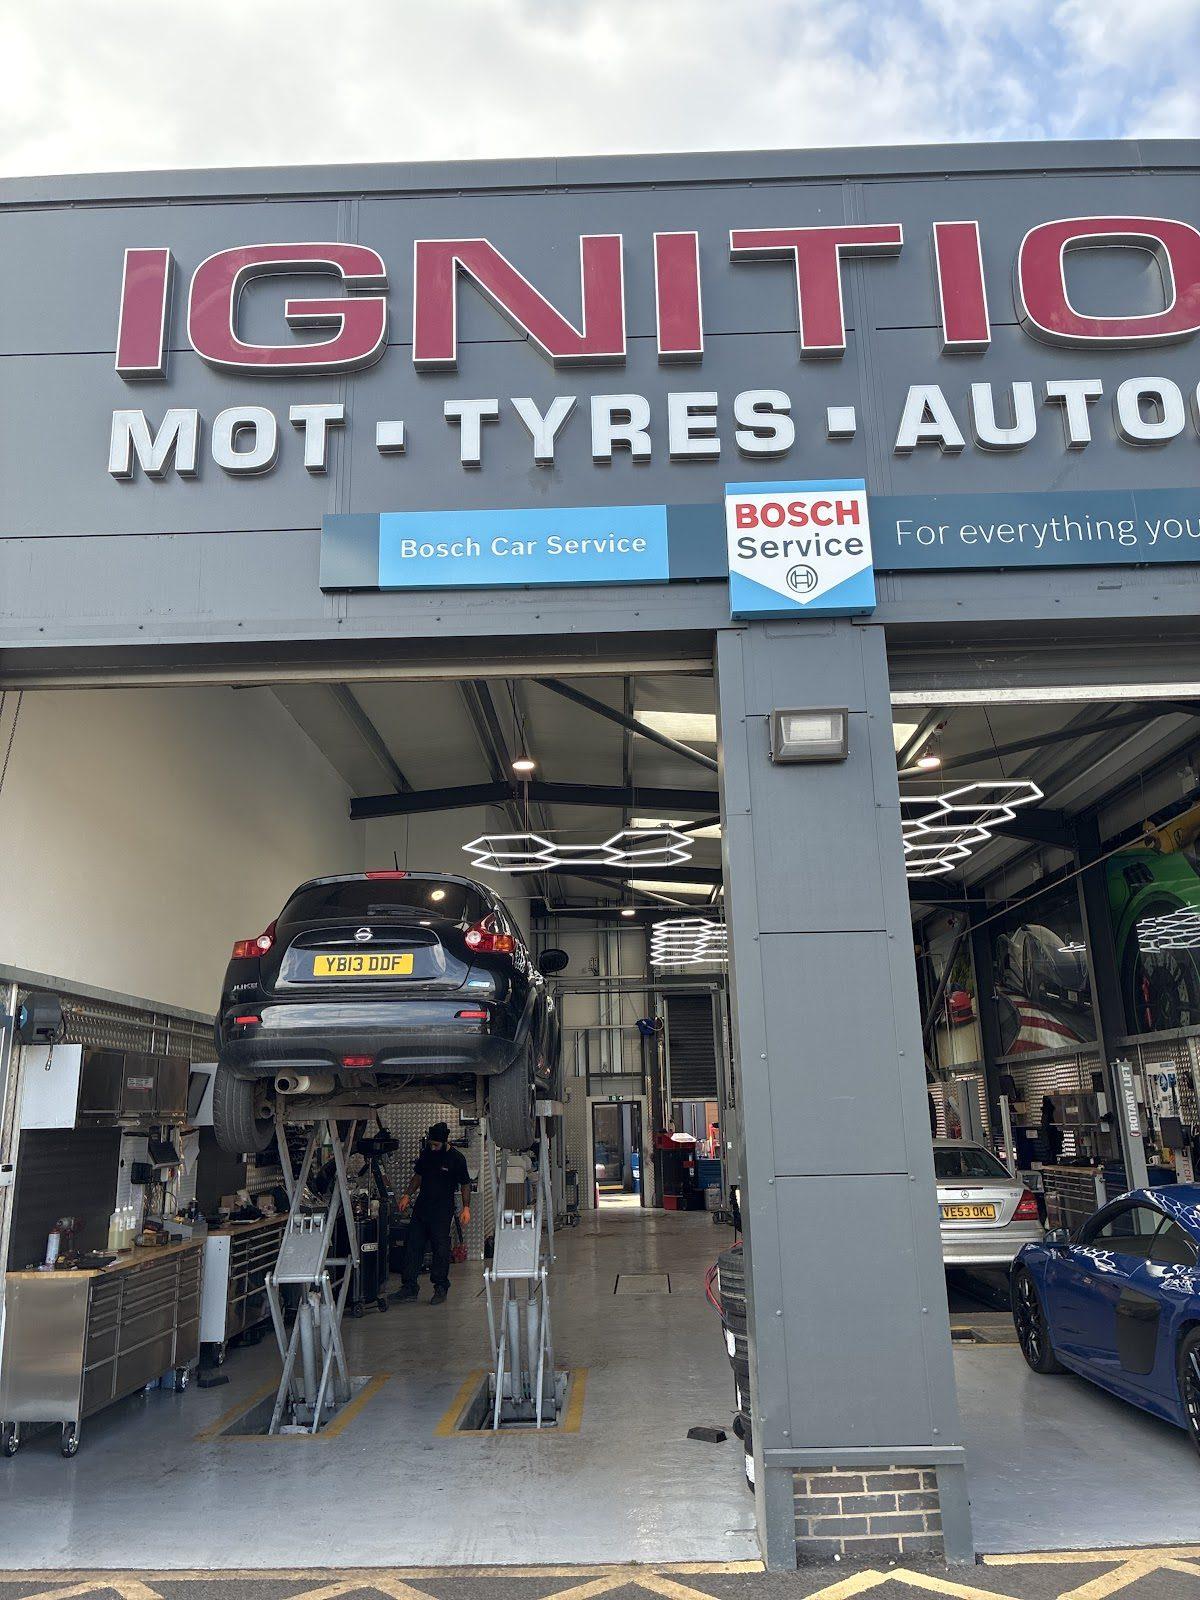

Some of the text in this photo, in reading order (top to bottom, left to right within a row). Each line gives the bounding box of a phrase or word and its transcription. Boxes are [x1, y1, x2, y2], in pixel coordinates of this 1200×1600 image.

[108, 375, 1200, 480] MOT TYRES AUTO
[735, 500, 861, 529] BOSCH
[896, 514, 1200, 549] For everything you
[400, 532, 648, 559] Bosch Car Service
[736, 532, 864, 560] Service
[325, 955, 403, 972] YB13 DDF
[231, 982, 258, 992] JUKE
[1121, 1065, 1133, 1087] LIFT
[1125, 1090, 1139, 1131] ROTARY
[943, 1204, 993, 1218] VE53 OKL
